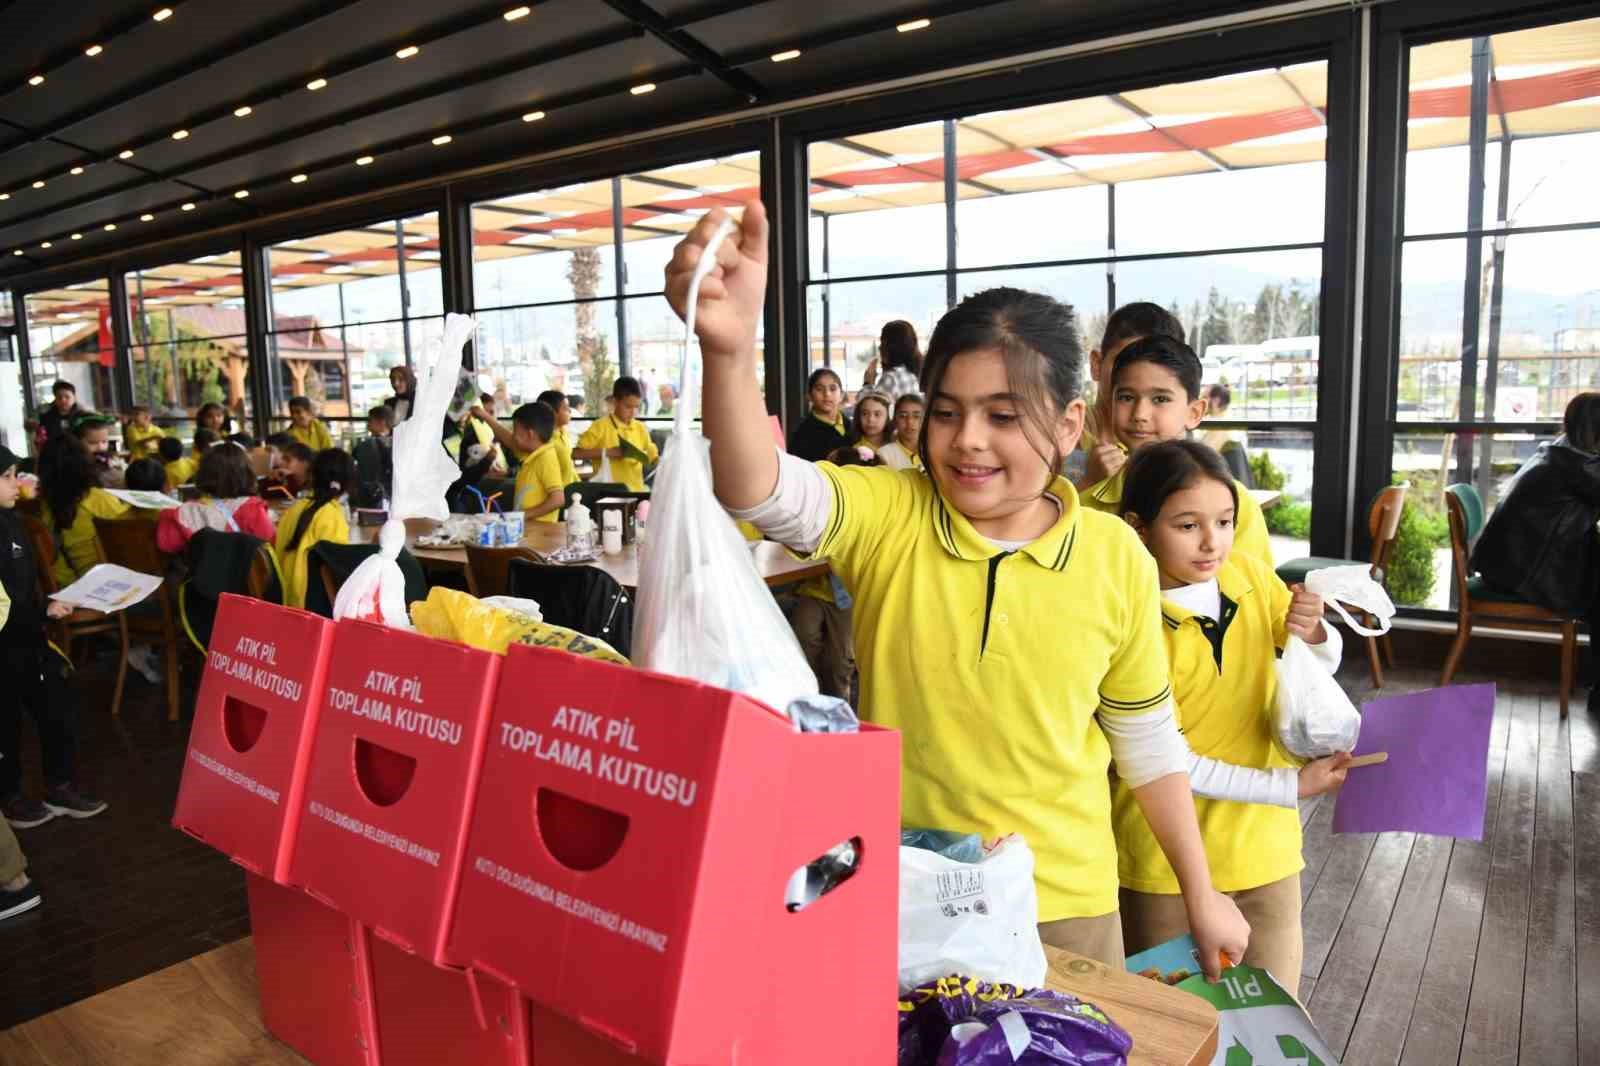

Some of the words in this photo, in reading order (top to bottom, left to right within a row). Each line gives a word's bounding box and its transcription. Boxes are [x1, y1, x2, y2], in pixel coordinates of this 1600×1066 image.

[235, 636, 260, 659] ATIK
[260, 642, 277, 666] PİL
[209, 650, 253, 684] TOPLAMA
[254, 668, 302, 702] KUTUSU
[364, 670, 399, 696] ATIK
[400, 676, 424, 703] PİL
[329, 687, 392, 725] TOPLAMA
[395, 707, 462, 745] KUTUSU
[552, 706, 602, 740] ATIK
[605, 717, 640, 752] PİL
[501, 722, 592, 775] TOPLAMA
[598, 754, 697, 807] KUTUSU
